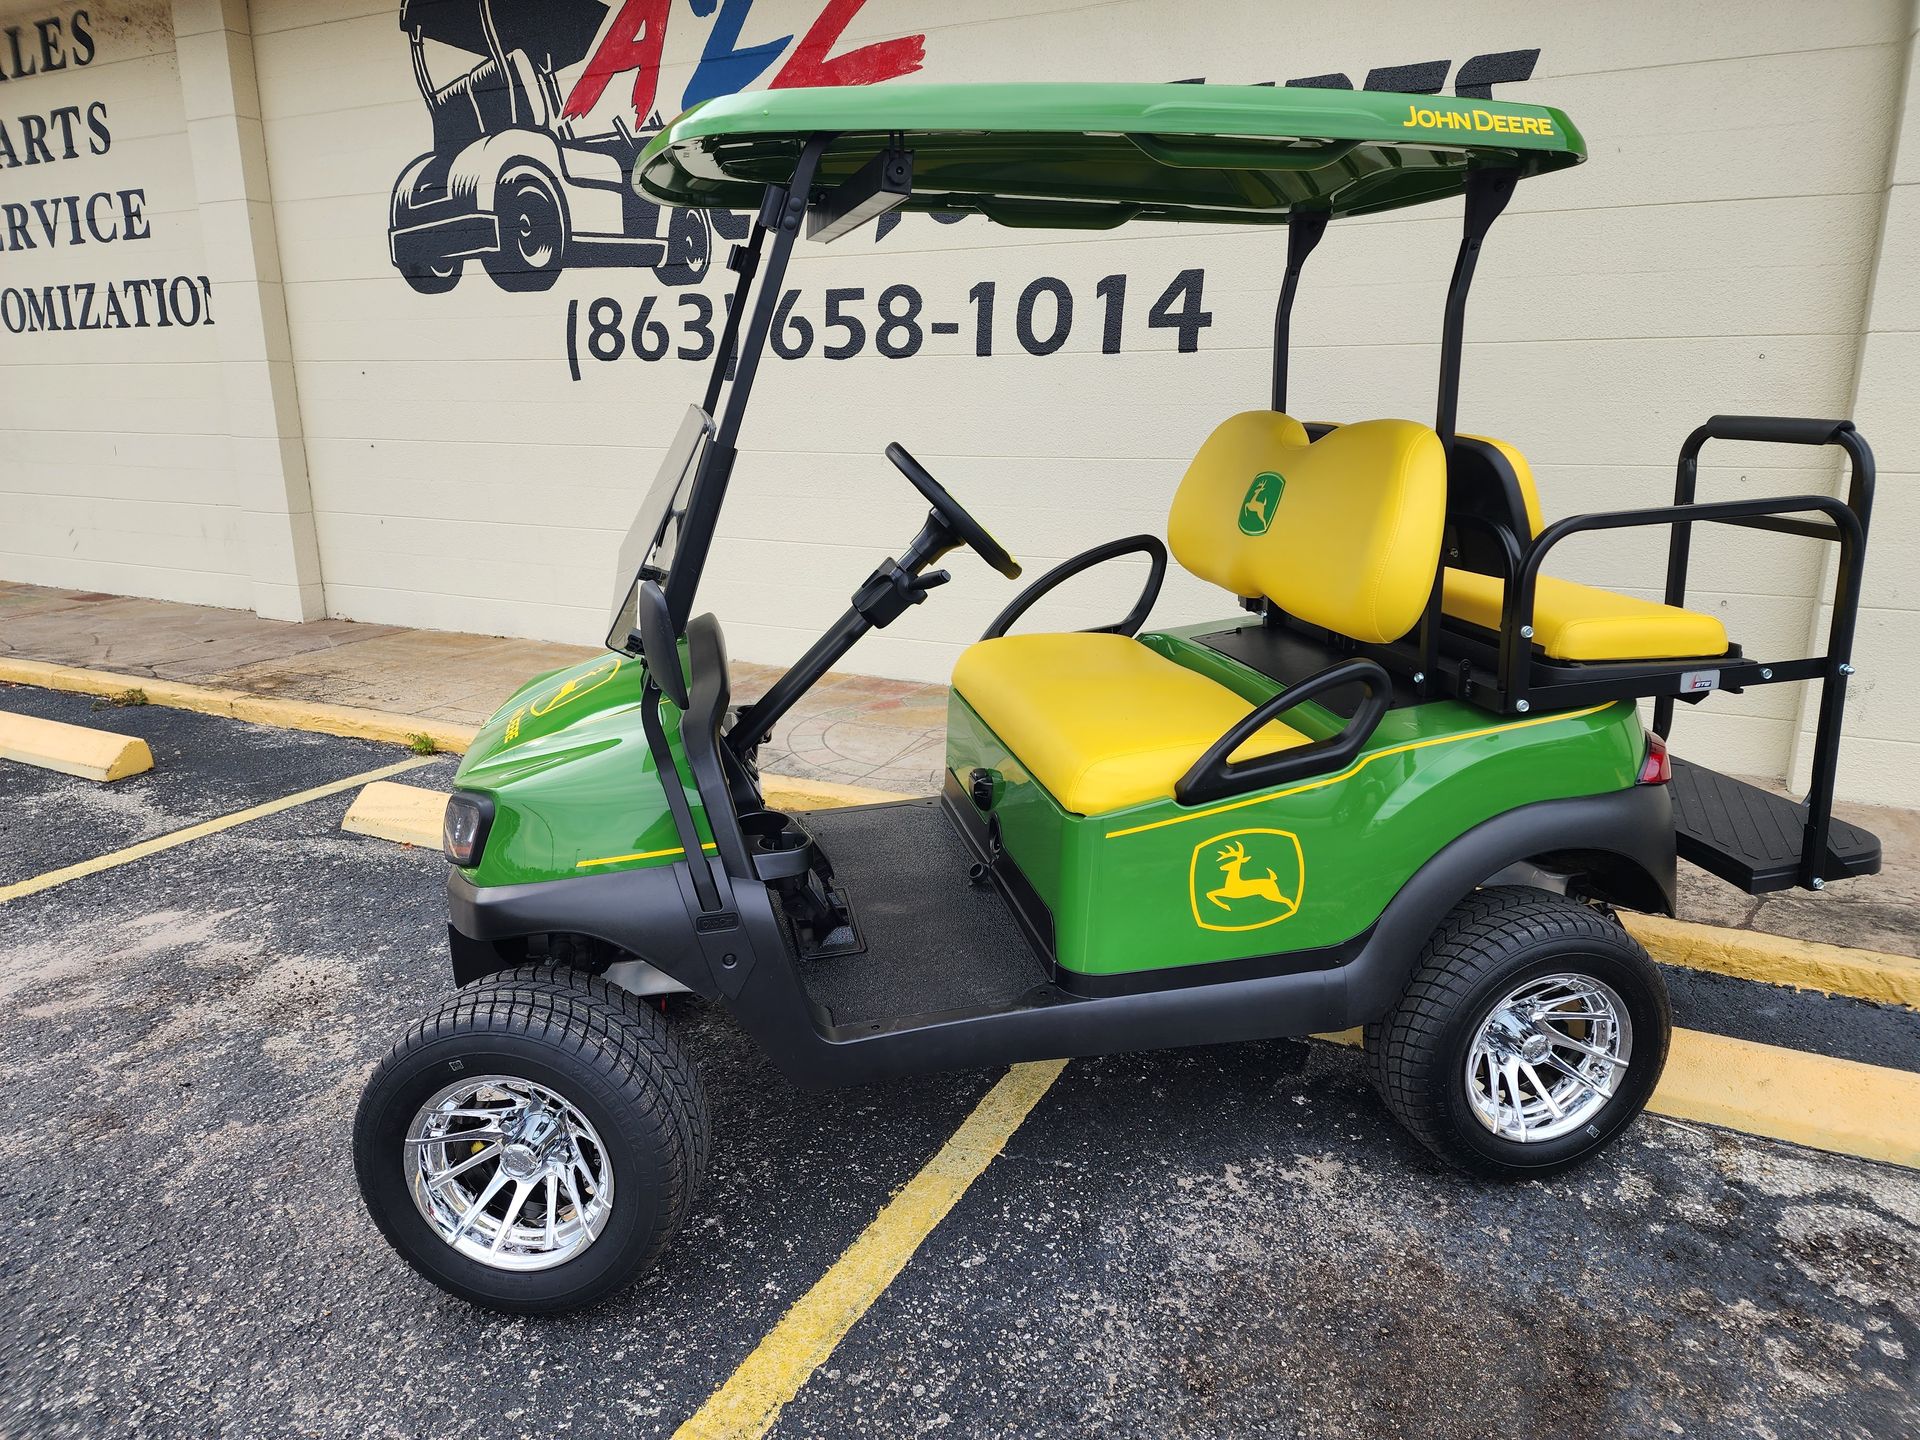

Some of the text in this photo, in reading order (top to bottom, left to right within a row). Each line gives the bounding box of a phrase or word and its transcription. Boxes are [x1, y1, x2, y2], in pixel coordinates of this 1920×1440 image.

[0, 9, 95, 82] LES
[1403, 105, 1554, 135] JOHN DEERE
[0, 188, 151, 251] RVICE
[769, 268, 1212, 360] 658-1014
